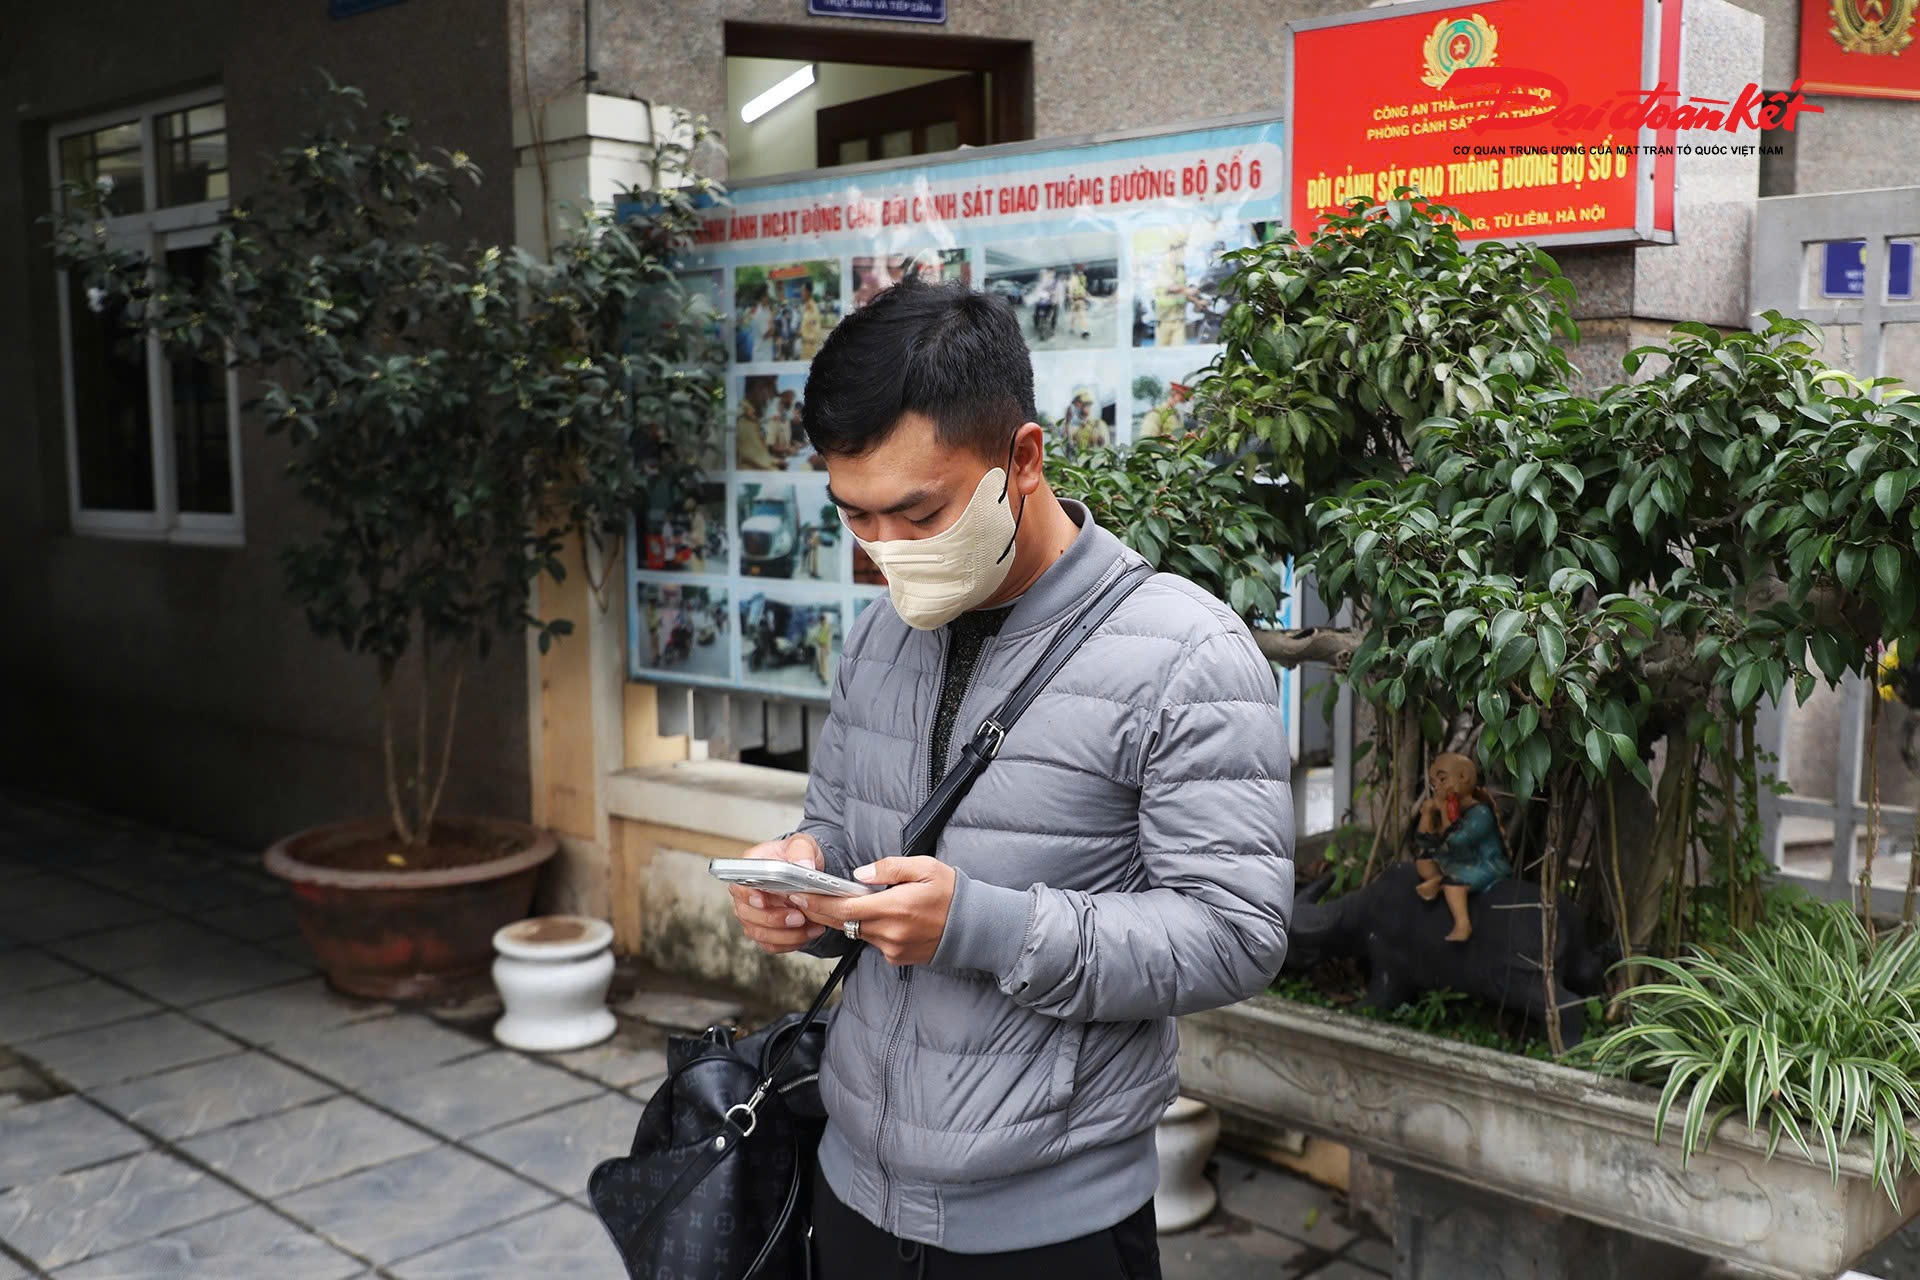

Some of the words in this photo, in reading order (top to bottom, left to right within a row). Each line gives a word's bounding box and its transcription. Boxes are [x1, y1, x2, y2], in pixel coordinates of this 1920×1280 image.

[1373, 105, 1409, 121] CÔNG
[1411, 103, 1429, 115] AN
[1366, 123, 1410, 141] PHÒNG
[1412, 118, 1447, 135] CẢNH
[1307, 172, 1332, 215] ĐỘI
[1334, 165, 1375, 206] CẢNH
[1377, 163, 1406, 202] SÁT
[1408, 165, 1444, 199] GIAO
[1447, 155, 1499, 195] THÔNG
[1501, 152, 1558, 190] ĐƯỜNG
[1561, 142, 1585, 190] BỘ
[1588, 134, 1613, 182] SỐ
[1615, 144, 1627, 178] 6
[729, 209, 758, 241] ẢNH
[761, 210, 798, 242] HOẠT
[801, 203, 841, 238] ĐỘNG
[913, 186, 957, 223] CẢNH
[962, 184, 994, 218] SÁT
[999, 184, 1039, 215] GIAO
[1044, 174, 1104, 210] THÔNG
[1110, 165, 1176, 204] ĐƯỜNG
[1182, 159, 1208, 201] BỘ
[1215, 150, 1242, 194] SỐ
[1250, 159, 1262, 189] 6
[1493, 212, 1513, 228] TỪ
[1515, 209, 1552, 227] LIÊM,
[1556, 206, 1577, 223] HÀ
[1580, 204, 1606, 222] NỘI
